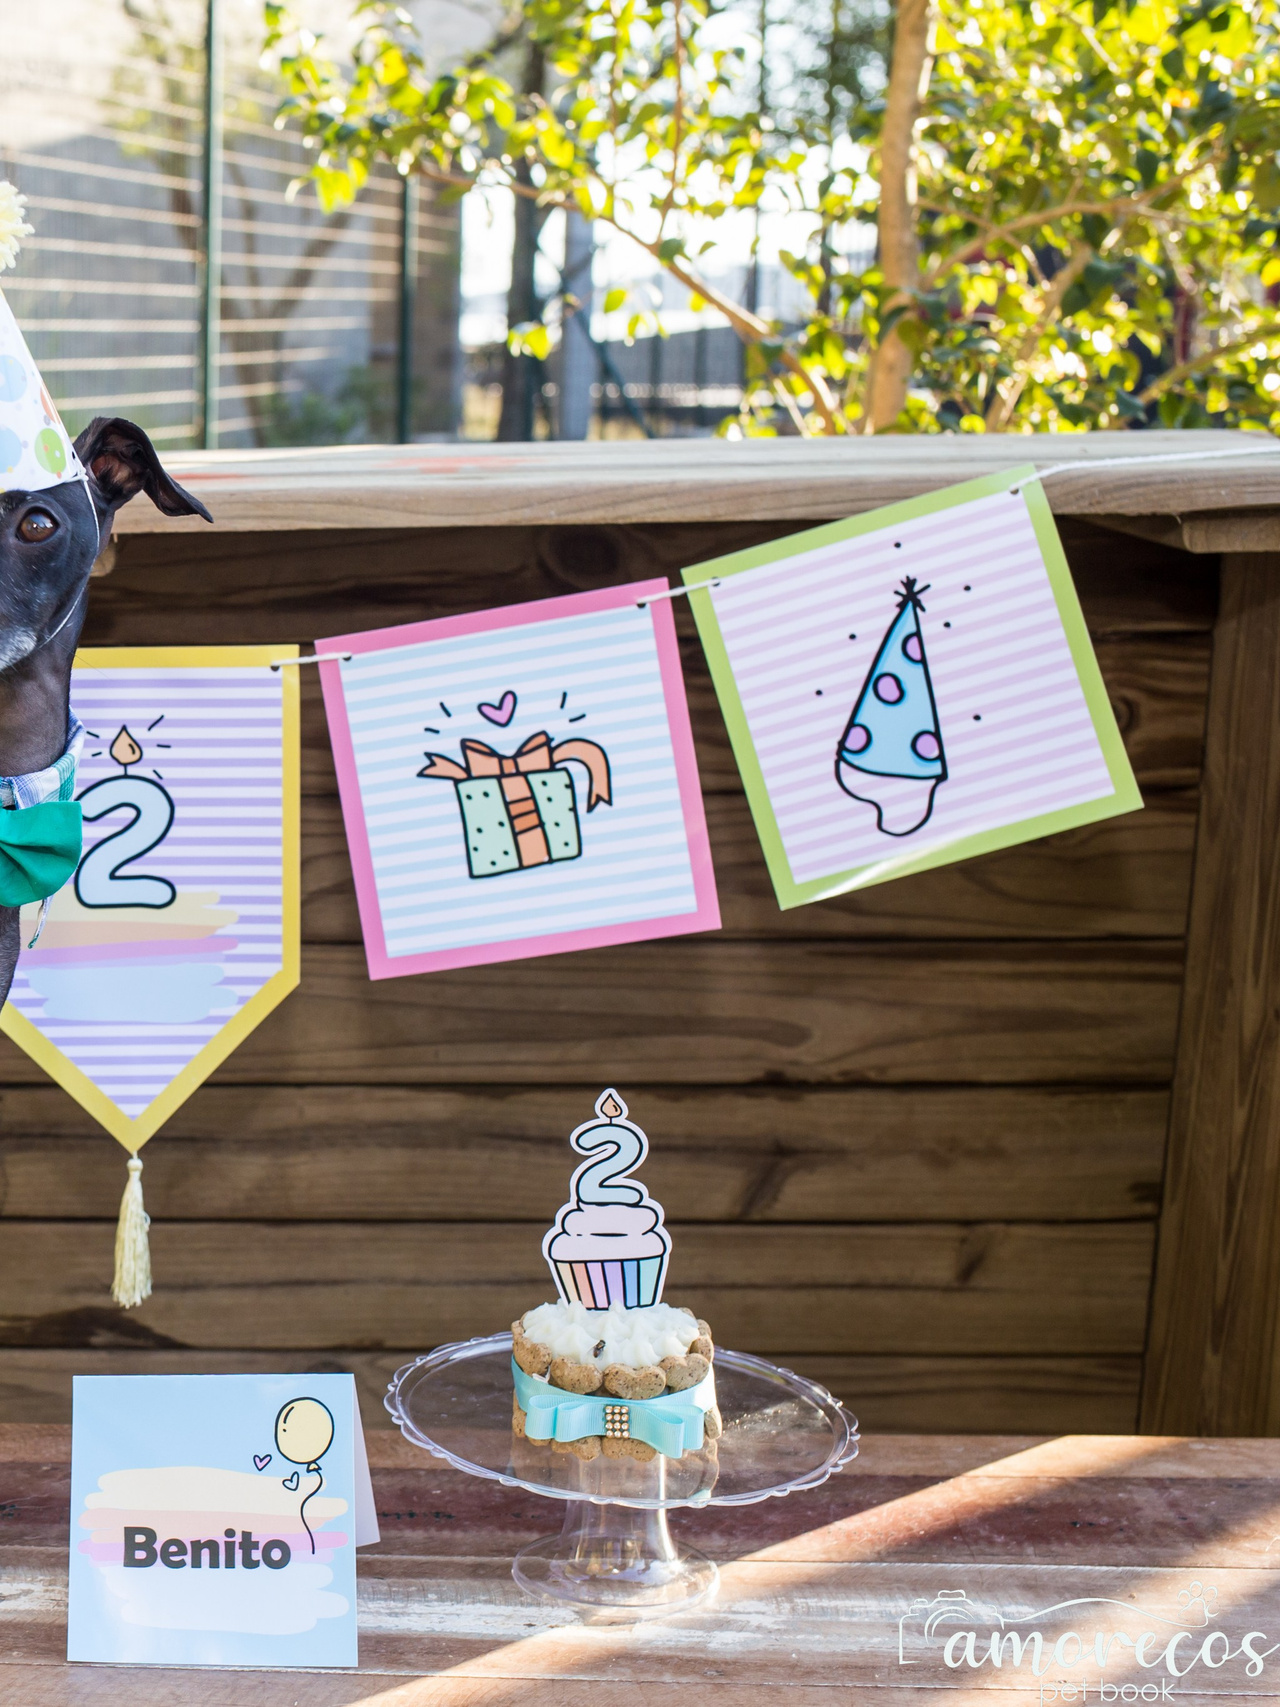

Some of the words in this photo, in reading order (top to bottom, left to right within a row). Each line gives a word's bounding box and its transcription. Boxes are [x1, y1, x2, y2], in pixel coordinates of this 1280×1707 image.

[73, 775, 177, 909] 2
[575, 1123, 644, 1206] 2
[123, 1526, 291, 1569] Benito
